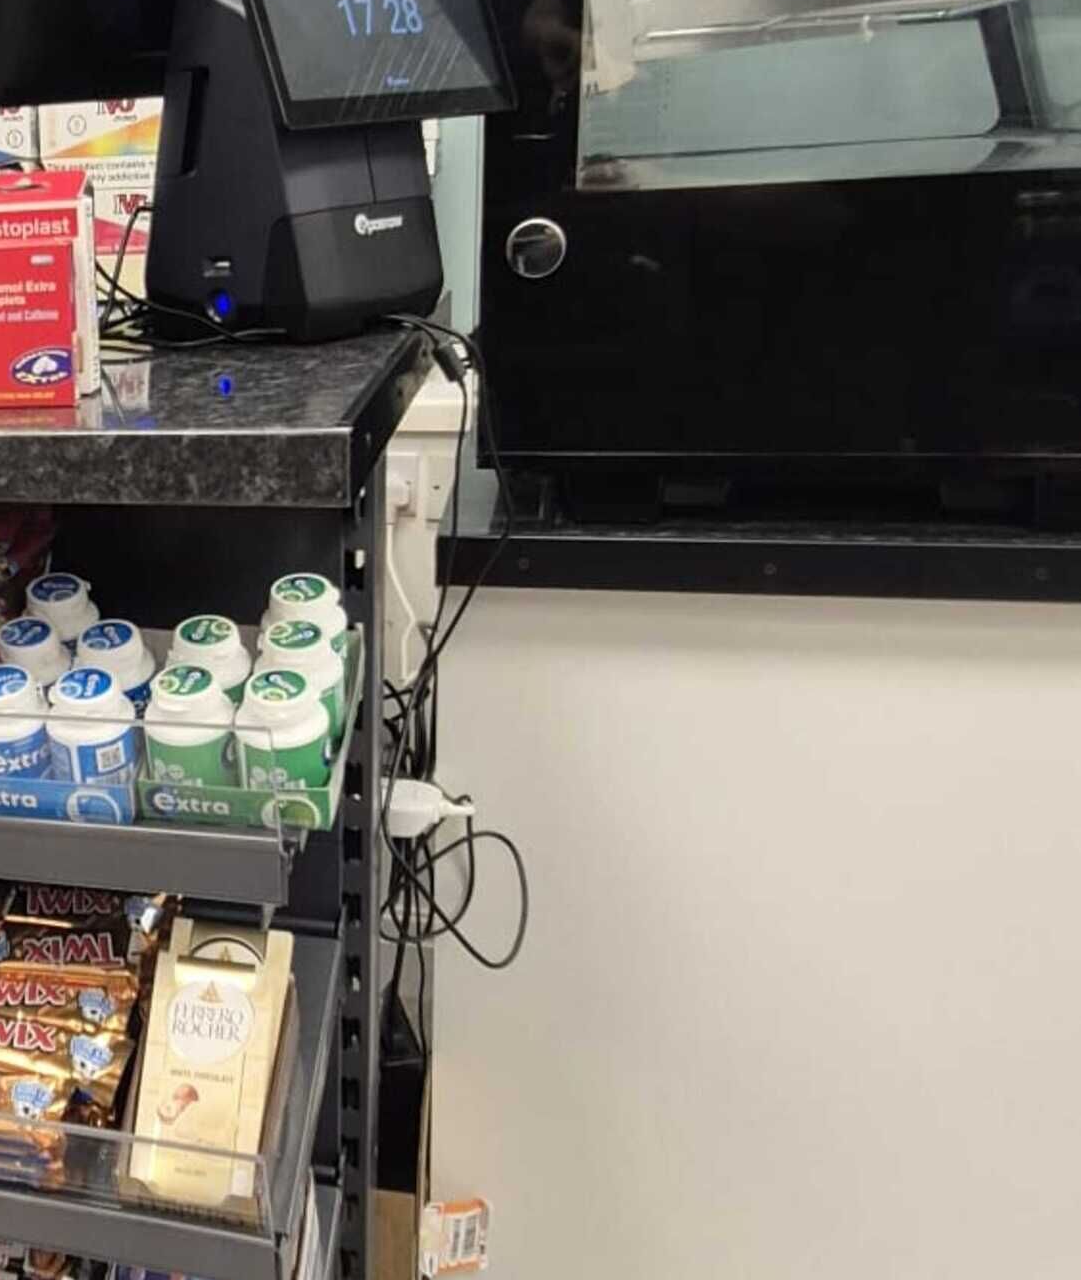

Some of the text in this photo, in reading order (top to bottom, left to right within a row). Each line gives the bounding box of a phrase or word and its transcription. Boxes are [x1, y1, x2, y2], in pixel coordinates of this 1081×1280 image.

[25, 281, 57, 293] Extra
[153, 789, 231, 815] extra
[21, 885, 111, 915] Twix
[22, 931, 124, 969] Twix
[173, 1000, 245, 1025] FERRERO
[171, 1020, 241, 1042] ROCHER
